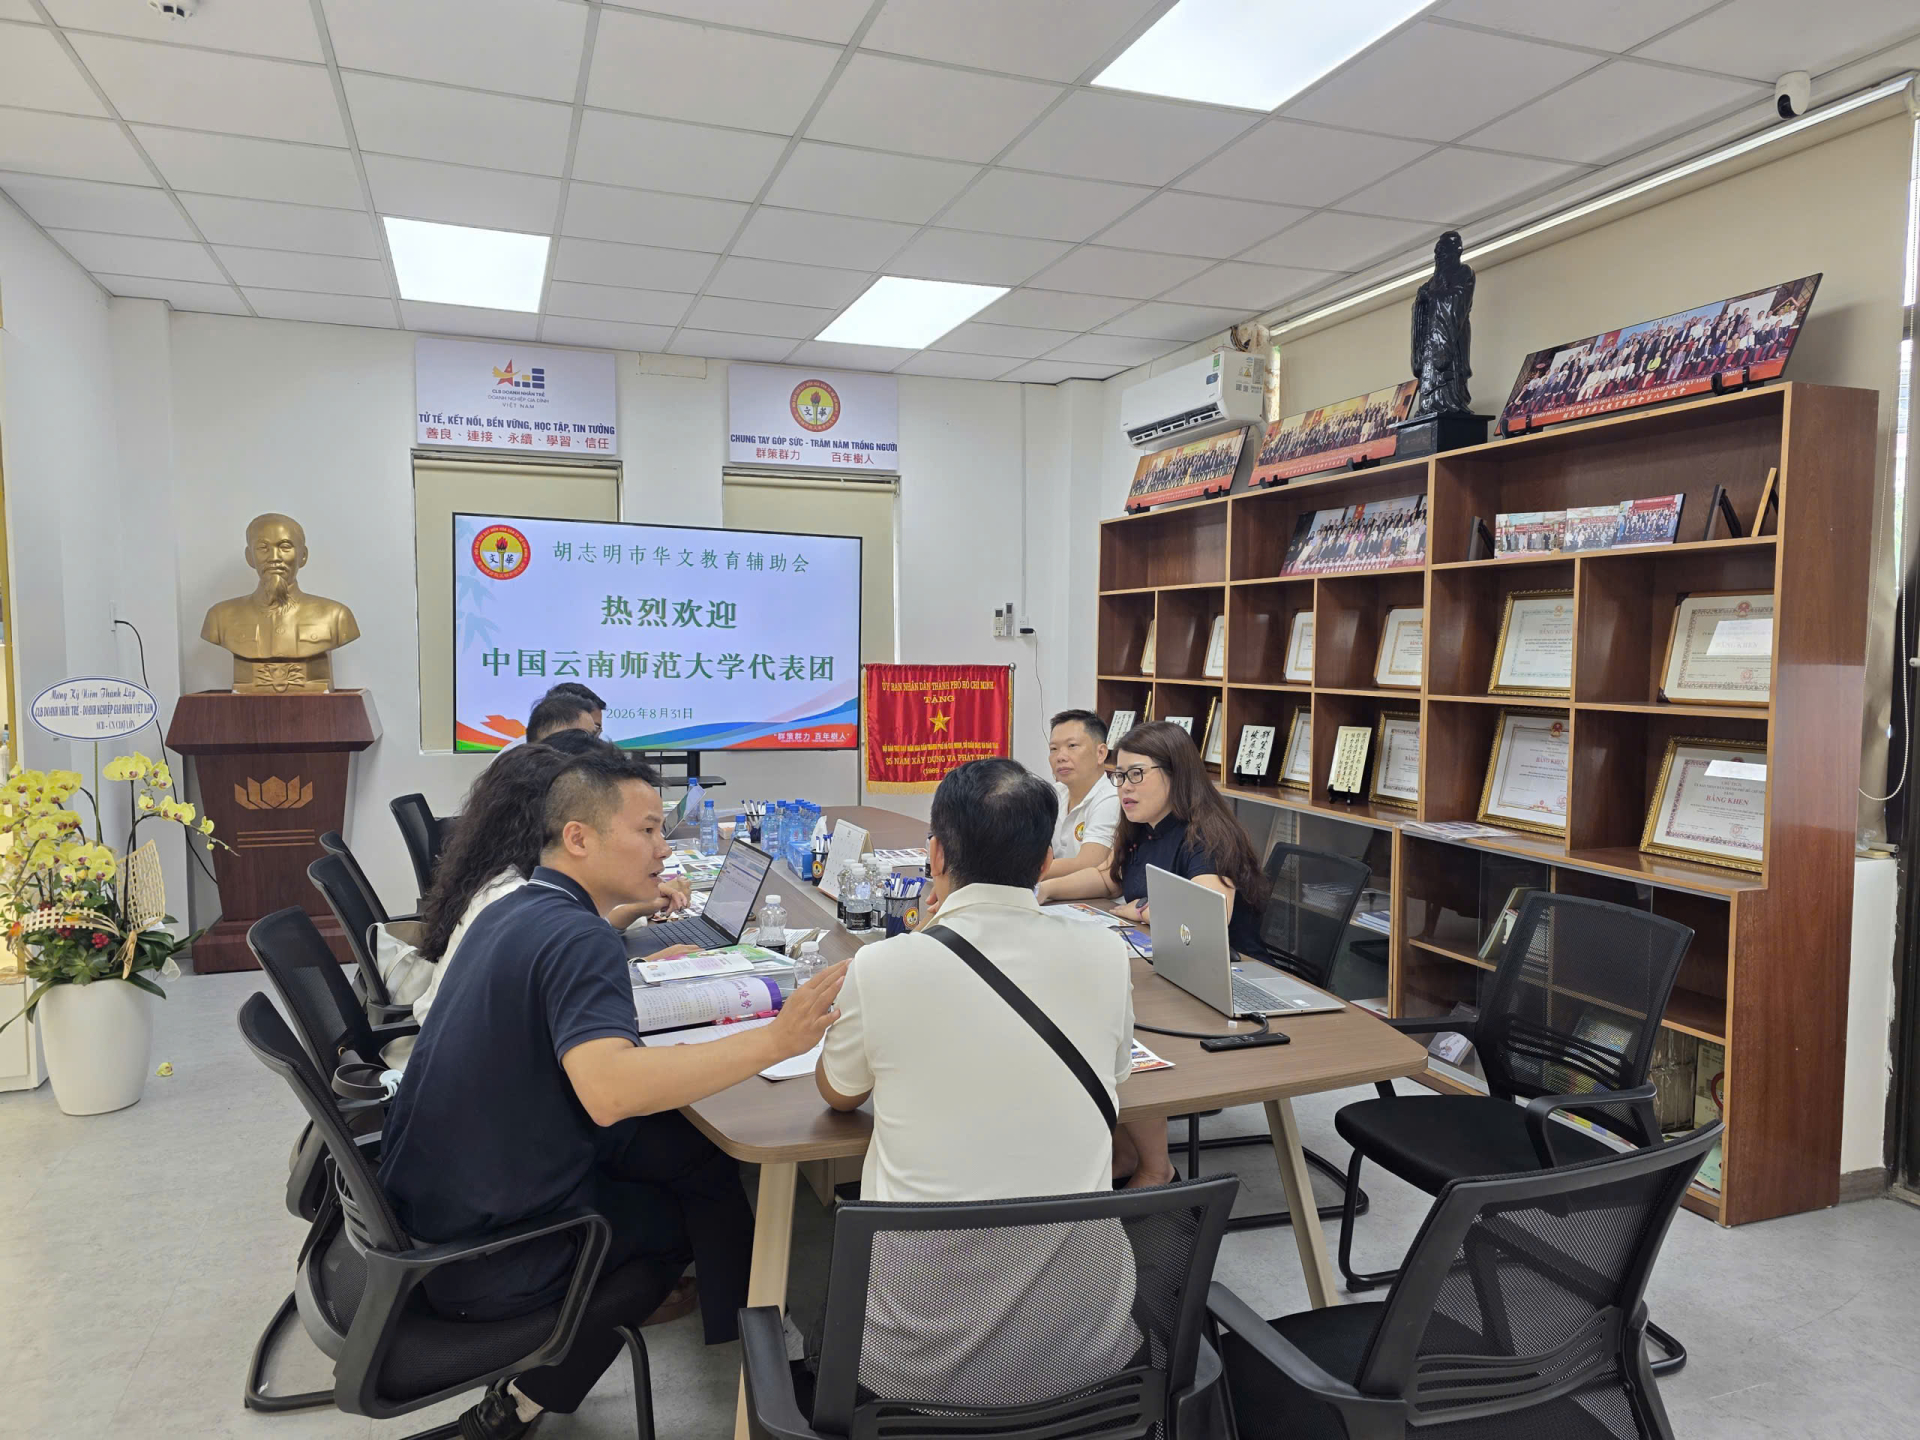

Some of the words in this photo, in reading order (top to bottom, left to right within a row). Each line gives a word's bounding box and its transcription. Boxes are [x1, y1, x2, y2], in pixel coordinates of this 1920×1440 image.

[419, 411, 431, 423] TỬ
[432, 412, 446, 425] TẾ,
[447, 413, 464, 426] KẾT
[466, 414, 484, 428] NỐI,
[506, 418, 532, 431] VỮNG,
[534, 421, 551, 432] HỌC
[553, 420, 571, 434] TẬP,
[572, 423, 586, 434] TIN
[730, 434, 756, 444] CHUNG
[757, 435, 770, 445] TAY
[772, 434, 787, 446] GÓP
[788, 436, 804, 447] SỨC
[756, 447, 800, 461] 群策群力
[831, 452, 875, 465] 百年樹人
[553, 541, 810, 573] 胡志明市华文教育辅助会
[601, 594, 738, 629] 热烈欢迎
[481, 647, 835, 682] 中国云南师范大学代表团
[923, 694, 955, 705] TẶNG
[911, 755, 926, 764] XÂY
[1706, 793, 1727, 803] BẰNG
[1727, 797, 1750, 805] KHEN
